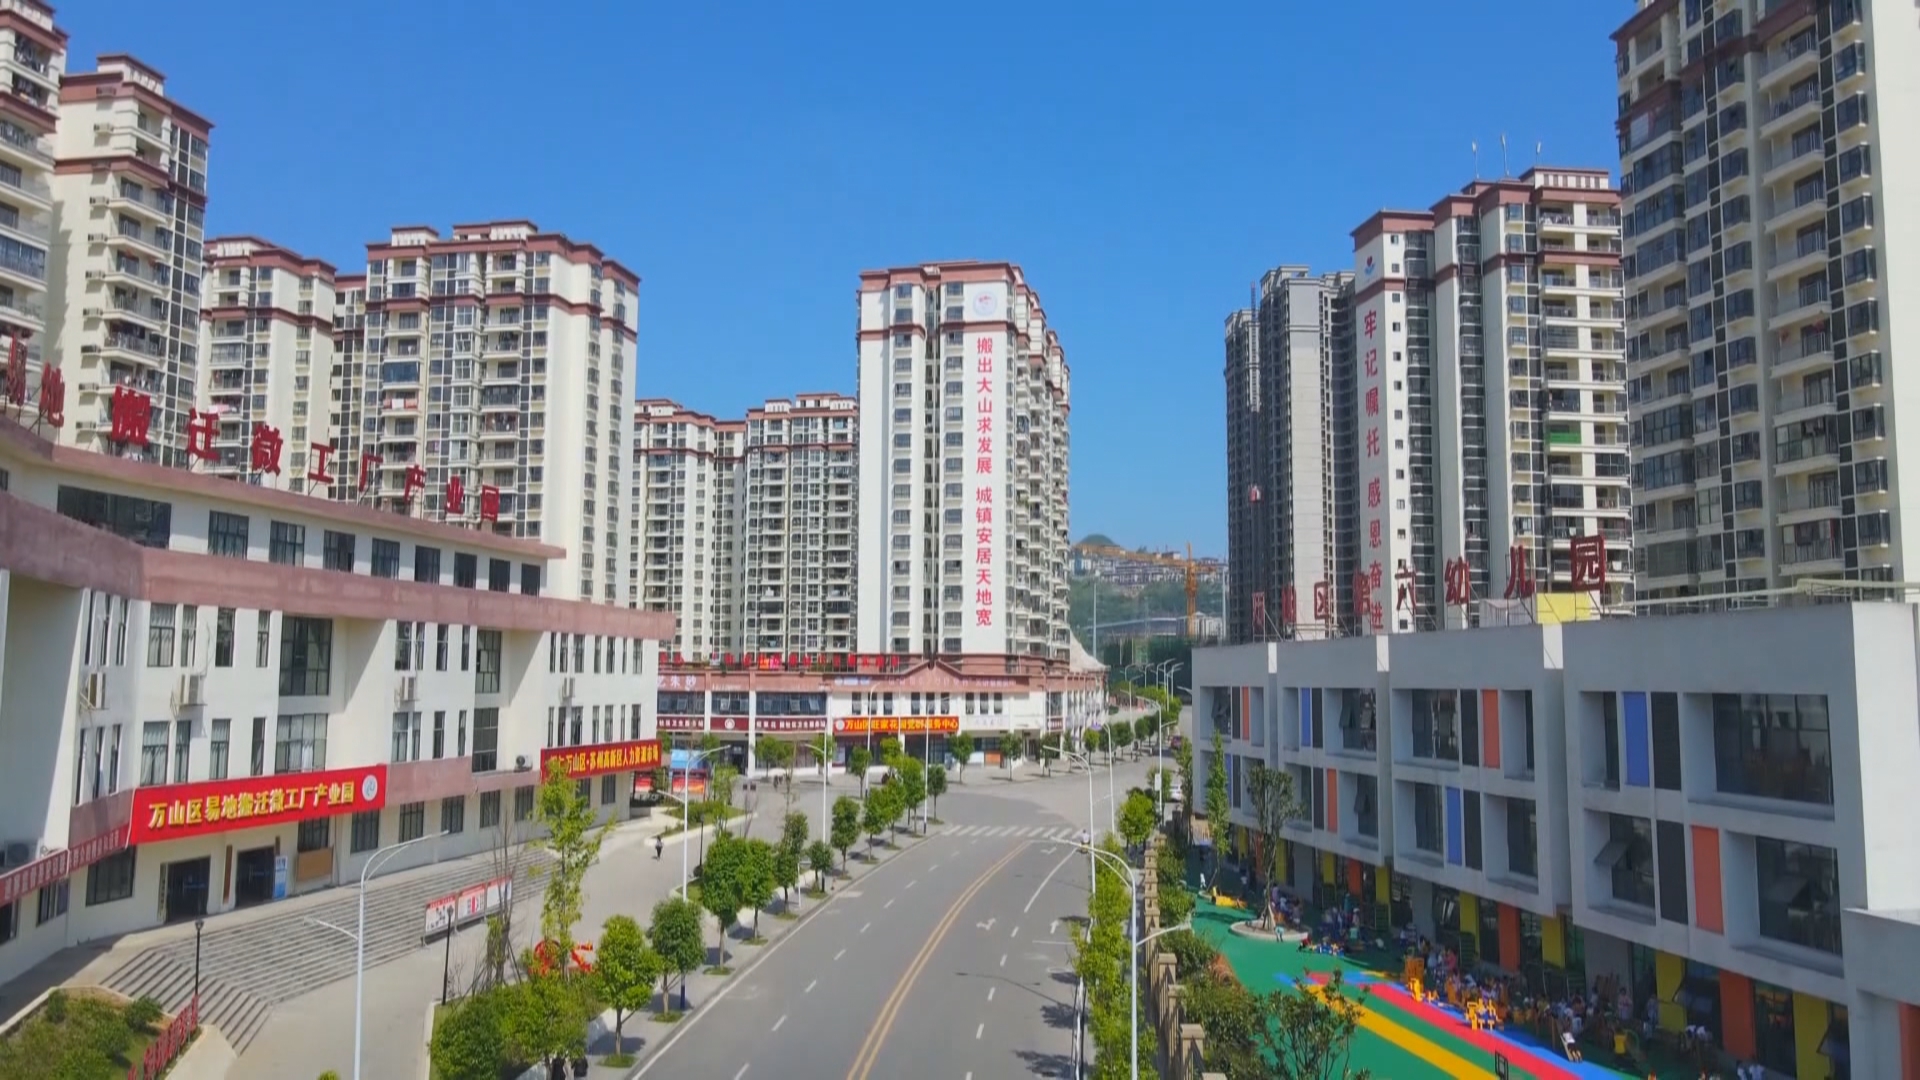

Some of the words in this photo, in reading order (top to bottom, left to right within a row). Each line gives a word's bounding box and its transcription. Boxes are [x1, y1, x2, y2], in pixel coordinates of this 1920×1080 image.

[976, 336, 993, 475] 搬出大山求发展
[1364, 309, 1380, 458] 牢记嘱托
[975, 486, 993, 627] 城镇安居天地宽
[1367, 477, 1383, 629] 感恩奋进
[148, 781, 355, 829] 万山区易地搬迁微工厂产业园
